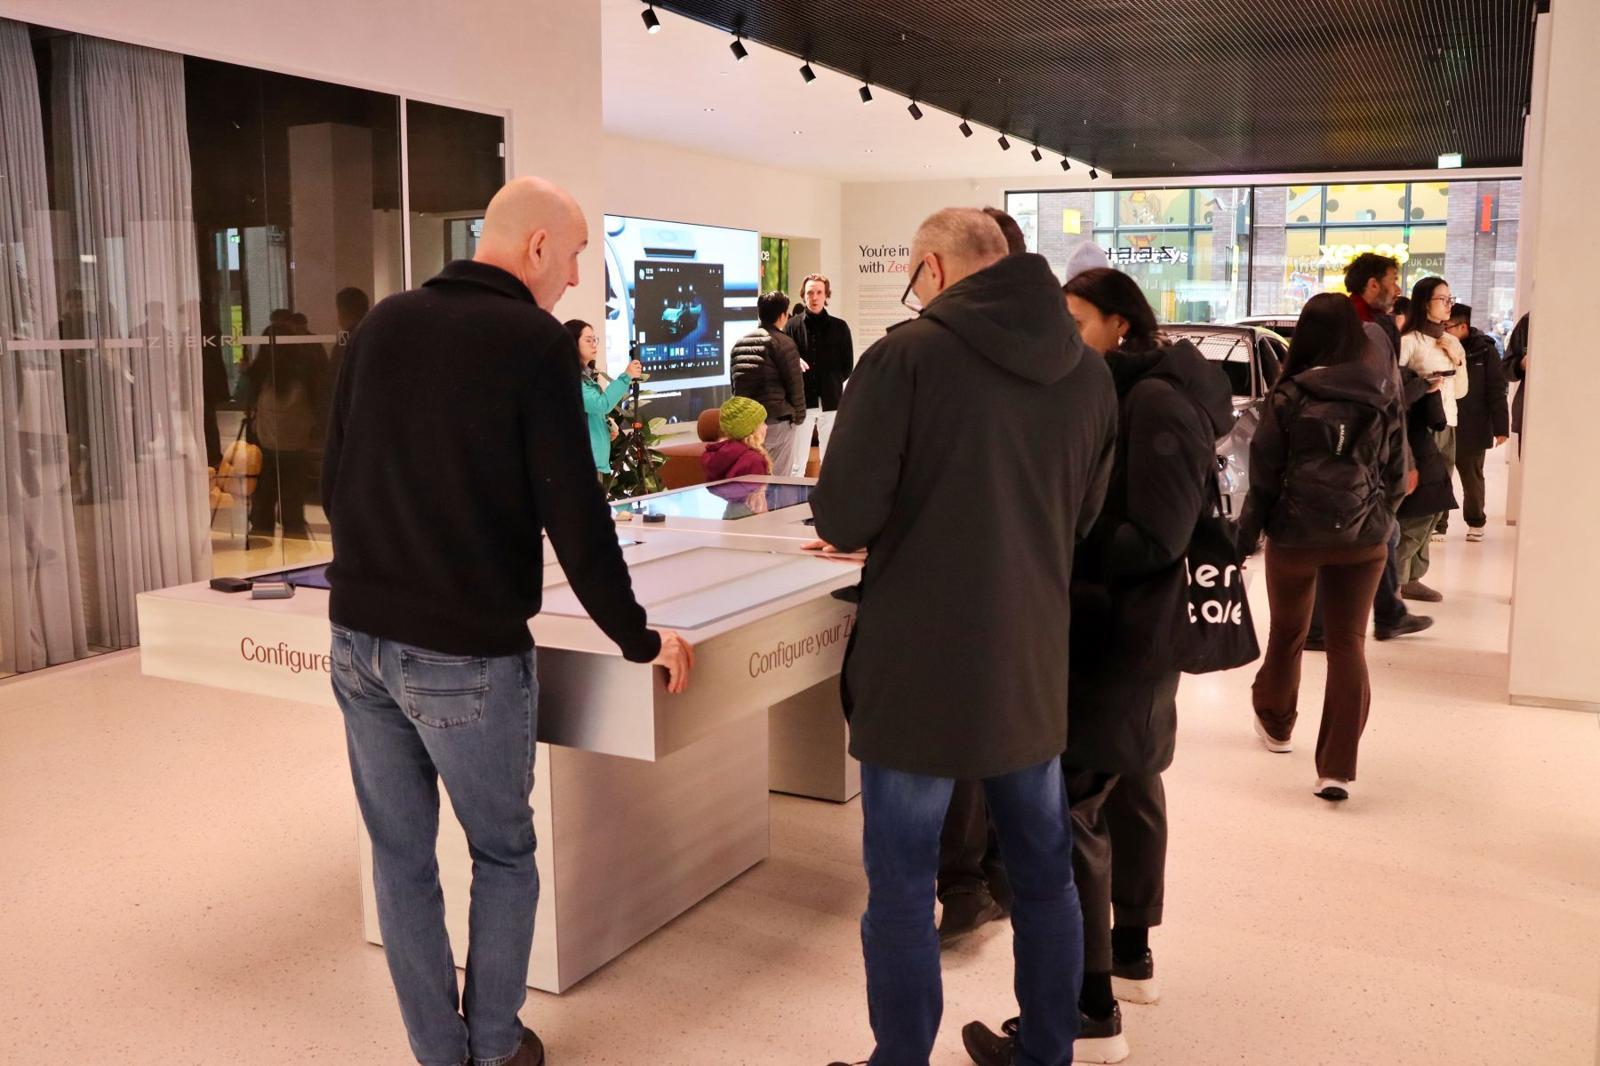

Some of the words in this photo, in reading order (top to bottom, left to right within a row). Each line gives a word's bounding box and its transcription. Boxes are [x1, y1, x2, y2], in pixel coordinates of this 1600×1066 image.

[859, 244, 896, 258] You're
[899, 244, 910, 257] in
[859, 260, 885, 273] with
[147, 335, 234, 348] ZEEKR
[241, 636, 332, 674] Configure
[749, 635, 814, 679] Configure
[815, 622, 842, 656] your
